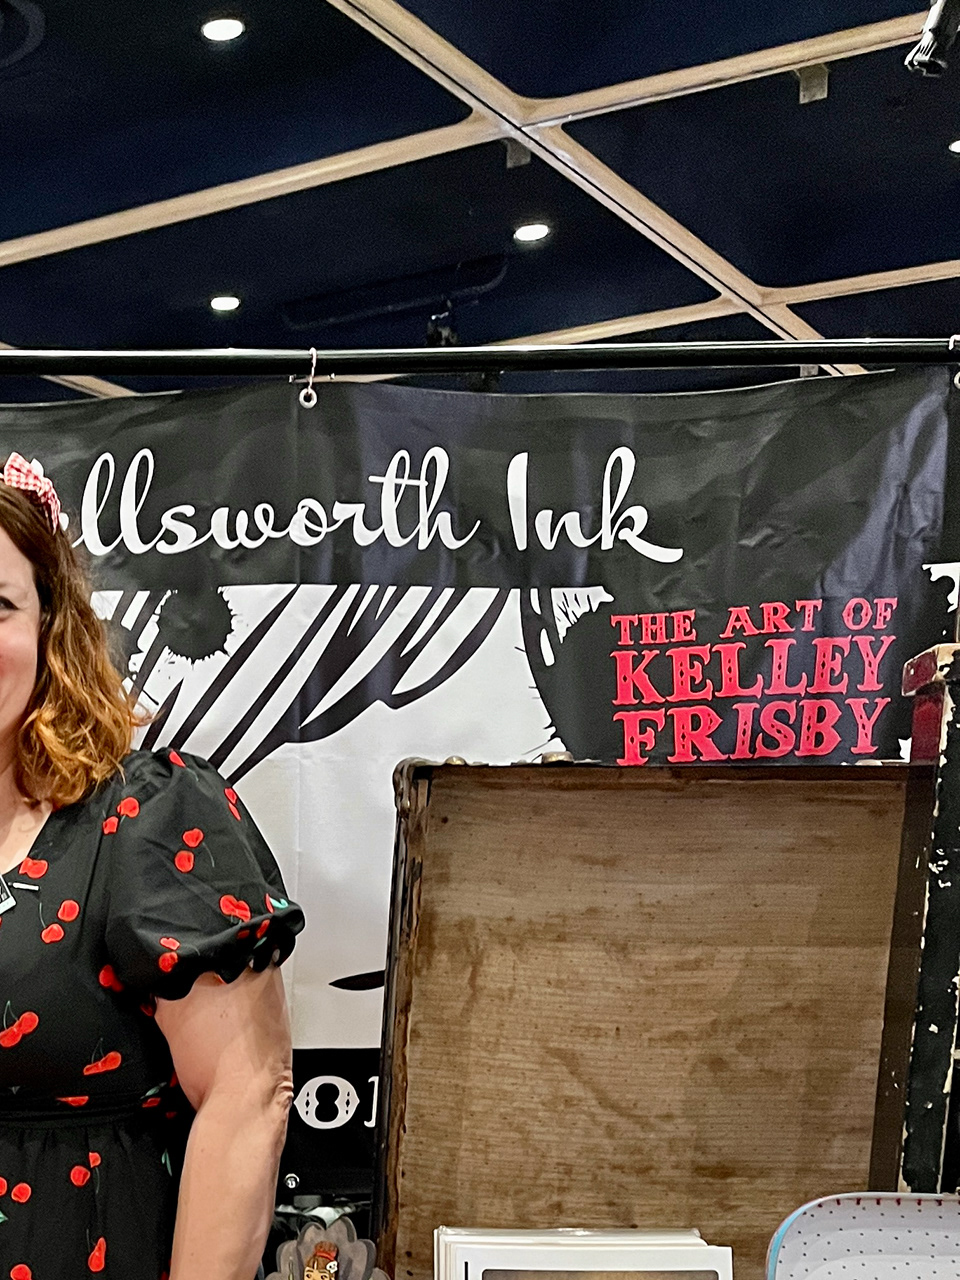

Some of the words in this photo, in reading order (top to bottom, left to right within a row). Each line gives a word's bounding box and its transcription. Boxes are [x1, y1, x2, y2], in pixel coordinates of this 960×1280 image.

[59, 446, 480, 555] llsworth
[507, 446, 684, 563] Ink
[610, 609, 697, 646] THE
[719, 598, 823, 639] ART
[842, 597, 898, 630] OF
[609, 635, 897, 706] KELLEY
[613, 697, 892, 766] FRISBY
